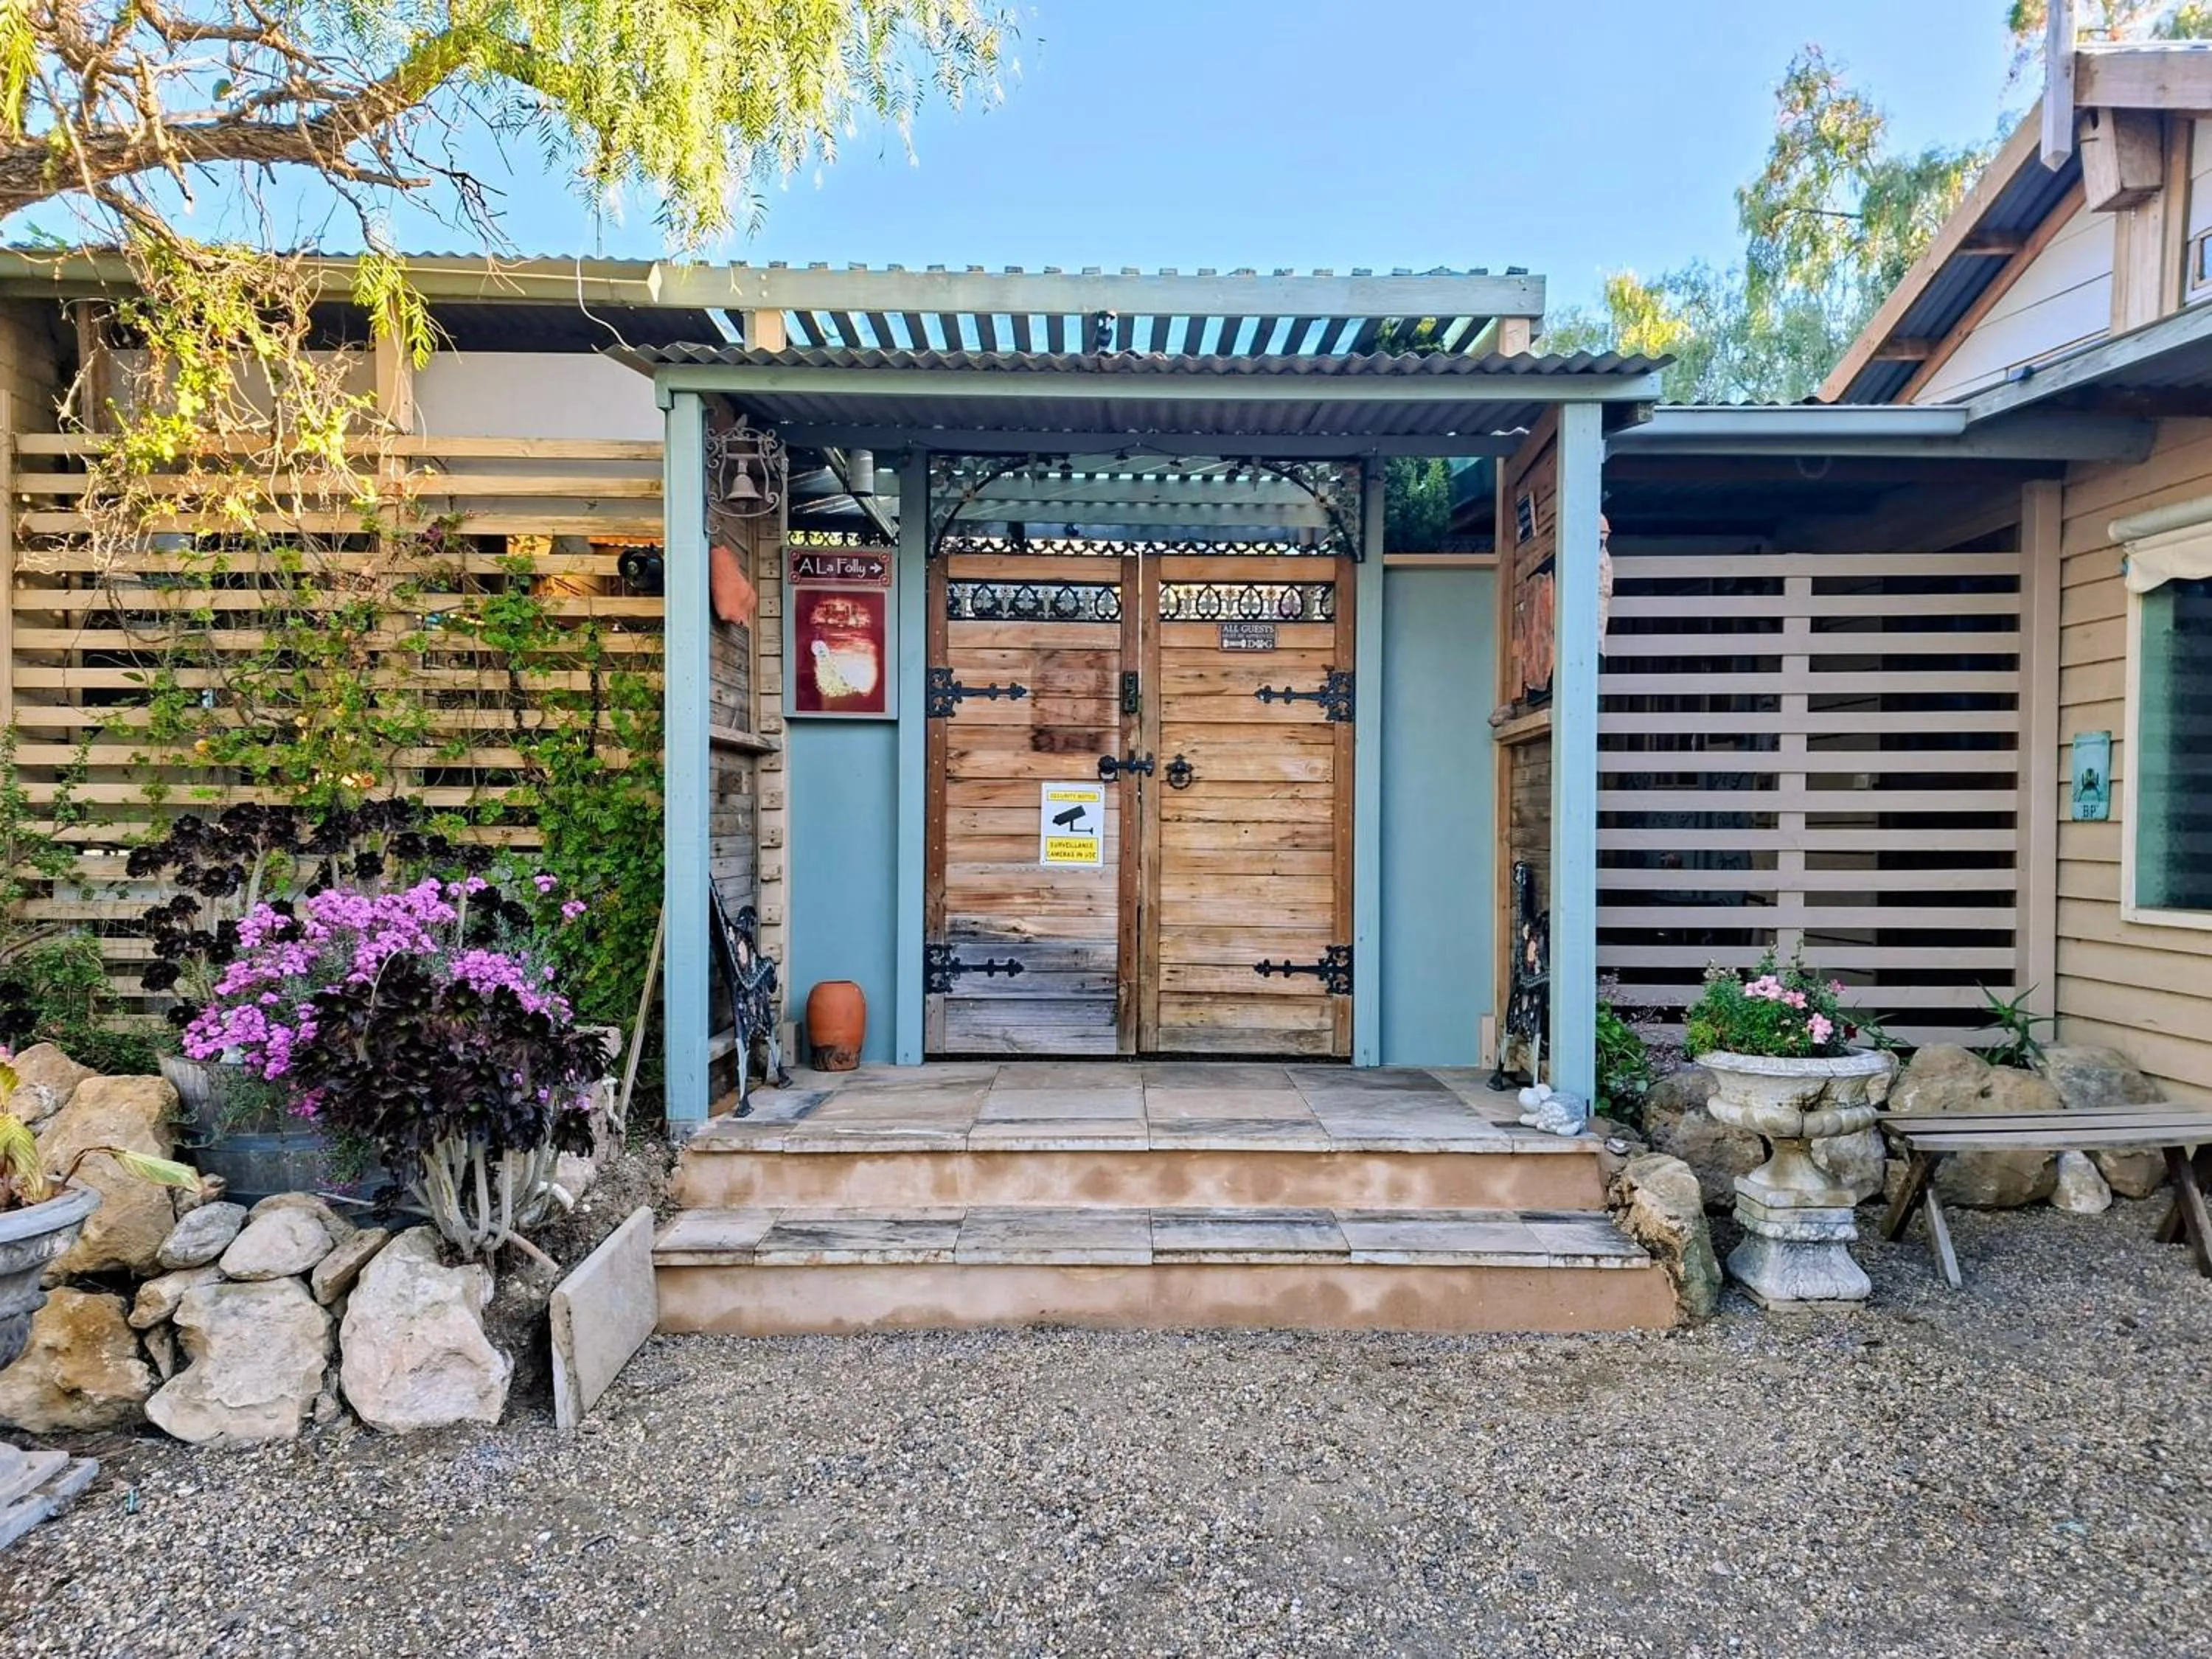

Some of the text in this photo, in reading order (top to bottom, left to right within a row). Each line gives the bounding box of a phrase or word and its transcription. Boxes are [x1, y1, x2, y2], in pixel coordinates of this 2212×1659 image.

[799, 557, 866, 578] A La Folly
[1222, 625, 1274, 633] ALL GUESTS
[1248, 639, 1273, 649] DG
